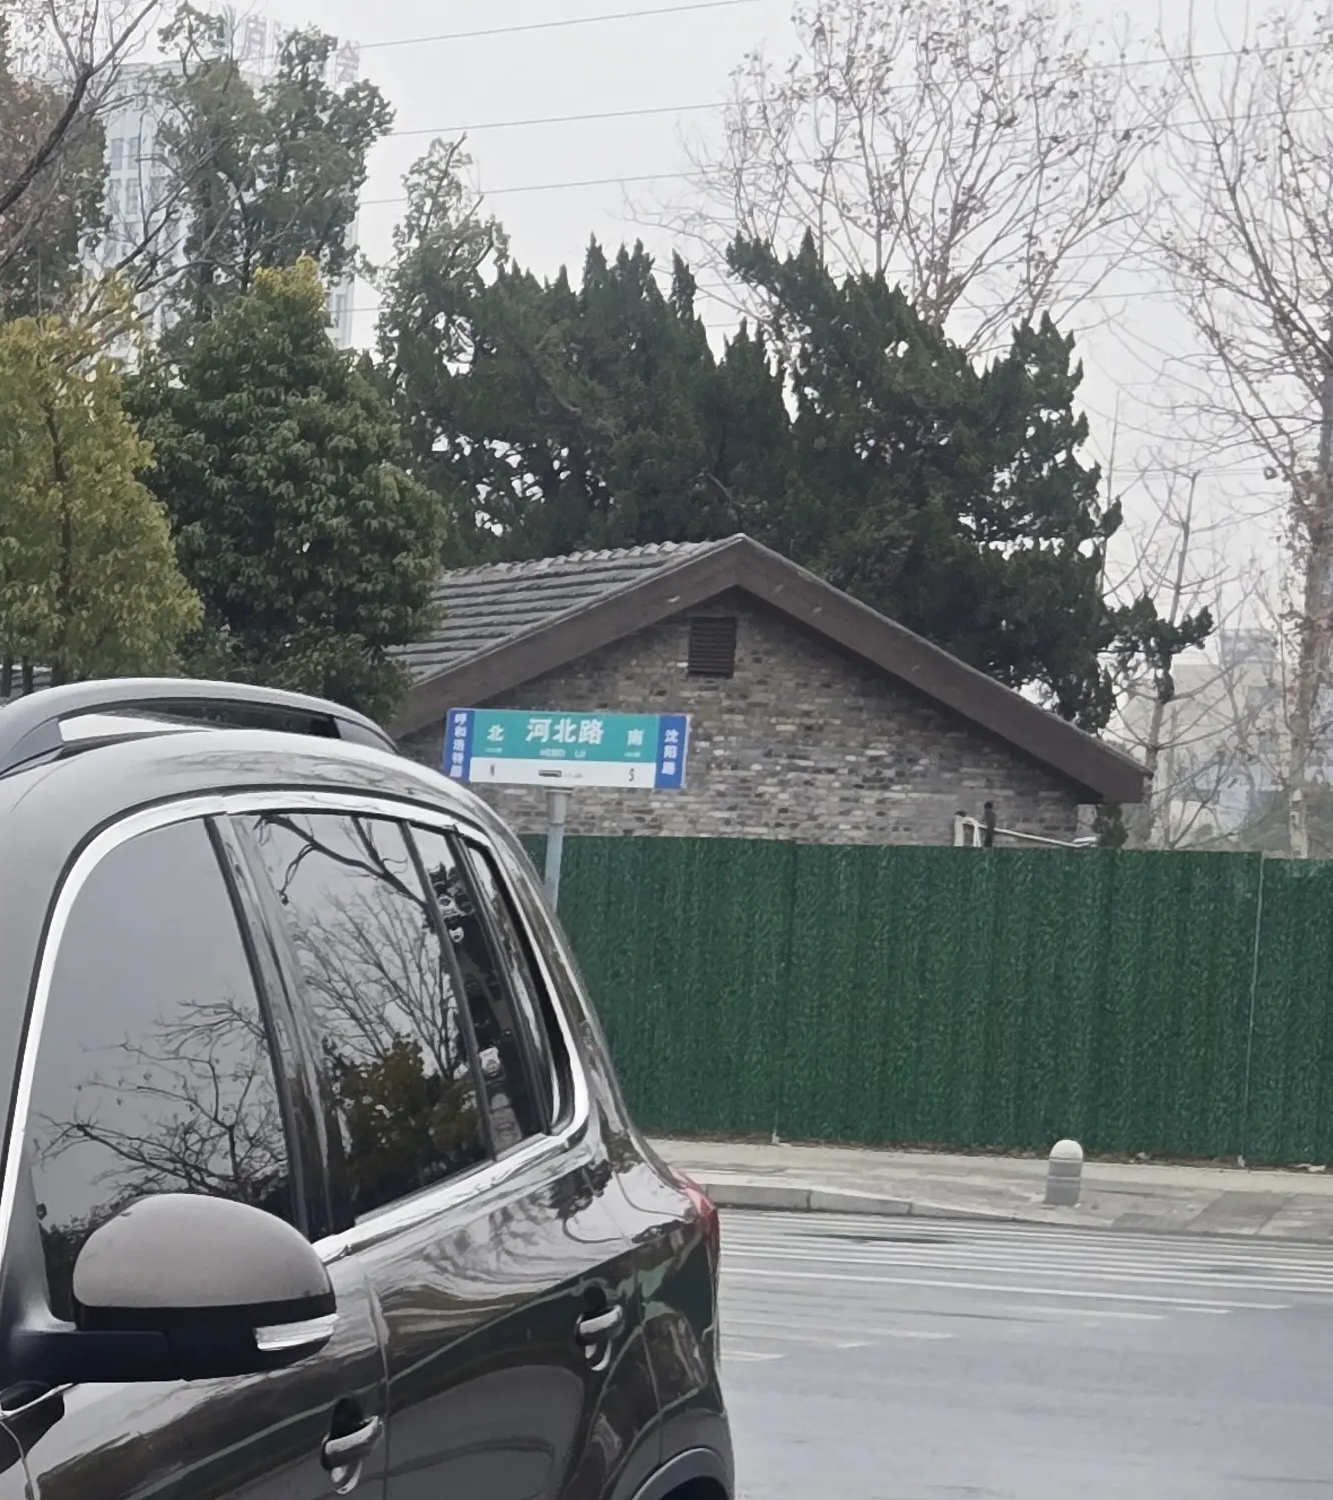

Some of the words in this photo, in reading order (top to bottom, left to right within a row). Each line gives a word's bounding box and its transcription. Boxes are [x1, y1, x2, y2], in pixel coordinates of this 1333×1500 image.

[486, 724, 505, 742] 北
[524, 717, 604, 745] 河北路
[627, 728, 645, 746] 南
